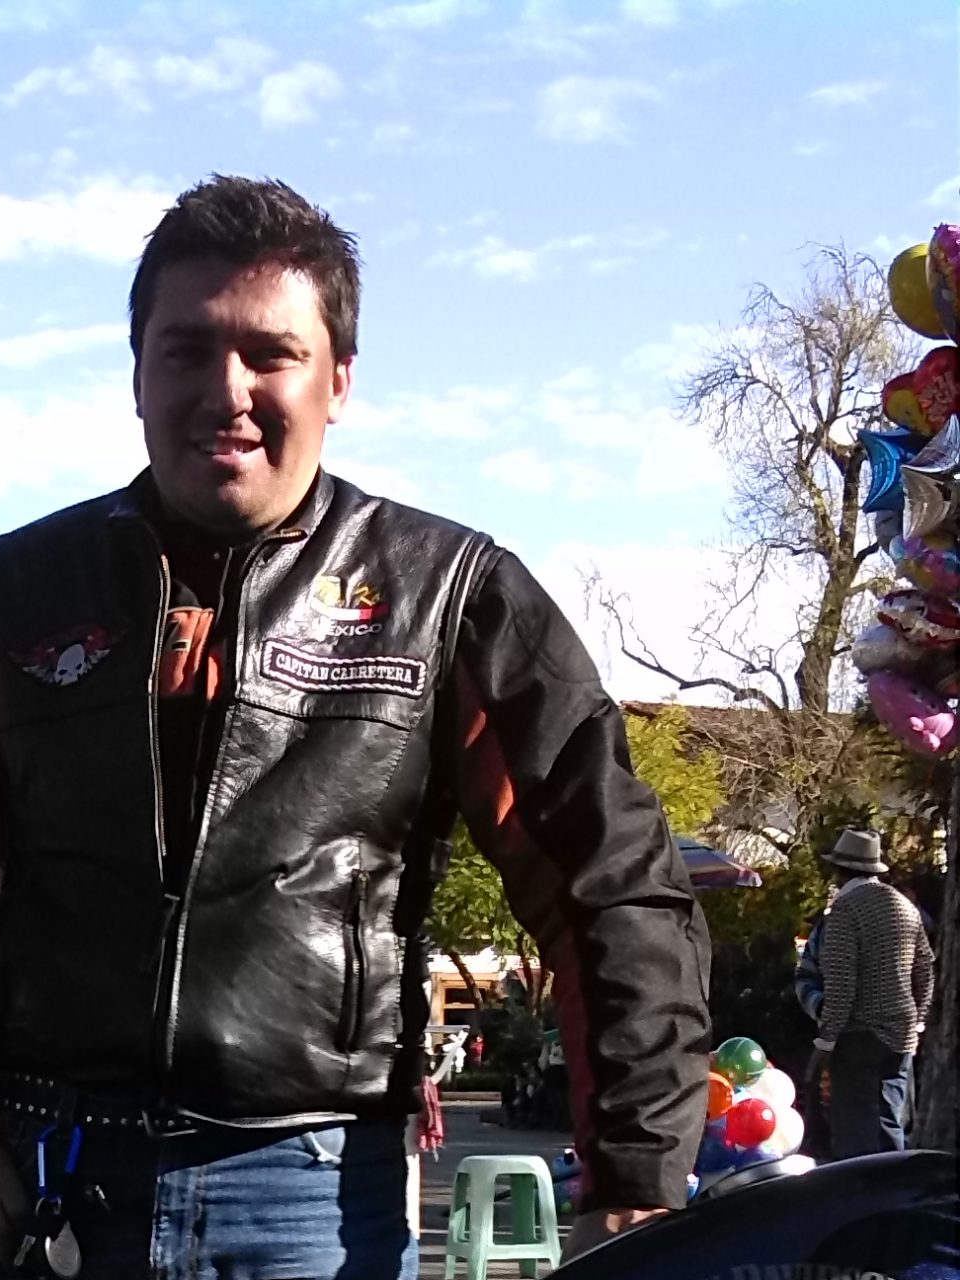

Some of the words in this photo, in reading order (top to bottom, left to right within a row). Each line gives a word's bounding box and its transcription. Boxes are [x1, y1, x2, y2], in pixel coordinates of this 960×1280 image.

[316, 622, 382, 637] EXICO
[275, 653, 329, 680] CAPITAN
[330, 666, 412, 683] CARRETERA
